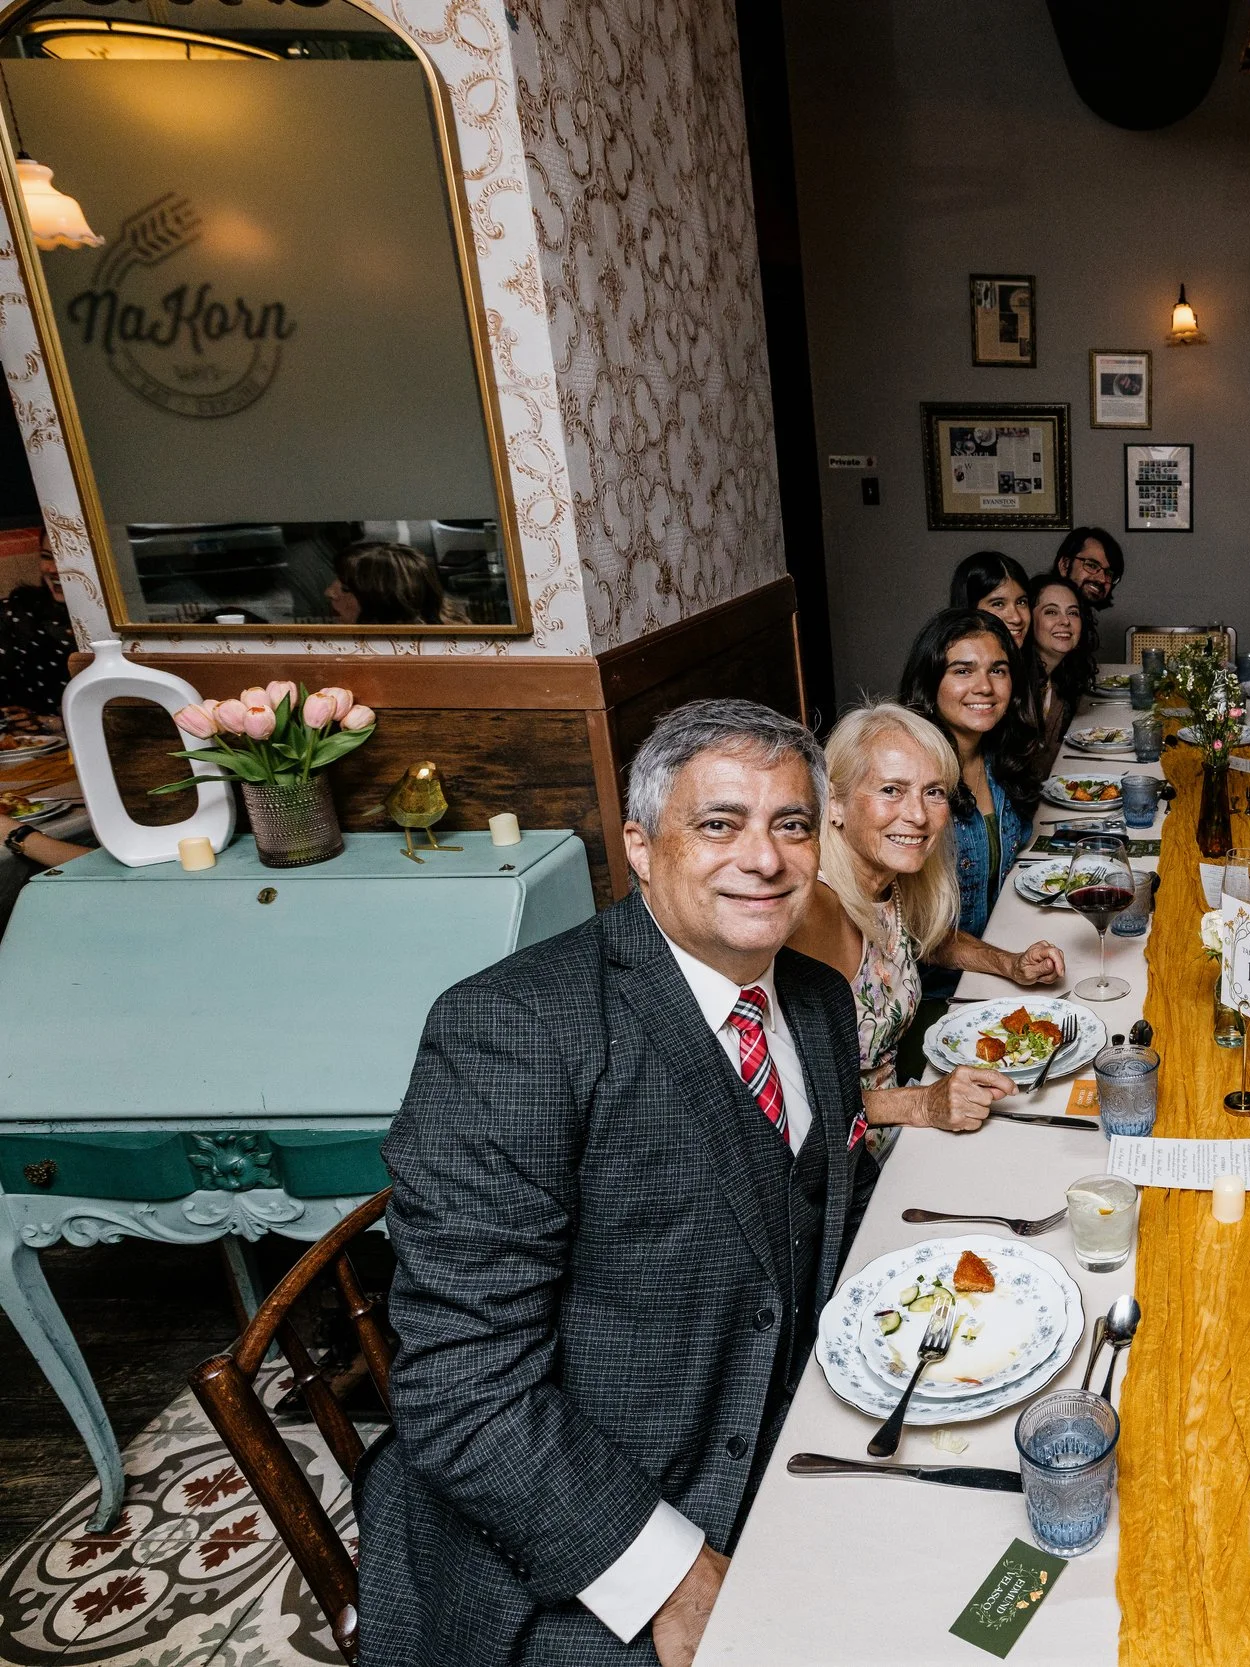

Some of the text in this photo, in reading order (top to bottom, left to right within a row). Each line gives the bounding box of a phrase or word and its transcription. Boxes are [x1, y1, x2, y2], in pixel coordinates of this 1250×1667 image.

[67, 283, 297, 355] NaKorn
[830, 458, 861, 466] Private
[983, 1571, 1015, 1611] VELASCO
[996, 1578, 1026, 1614] EDMUND
